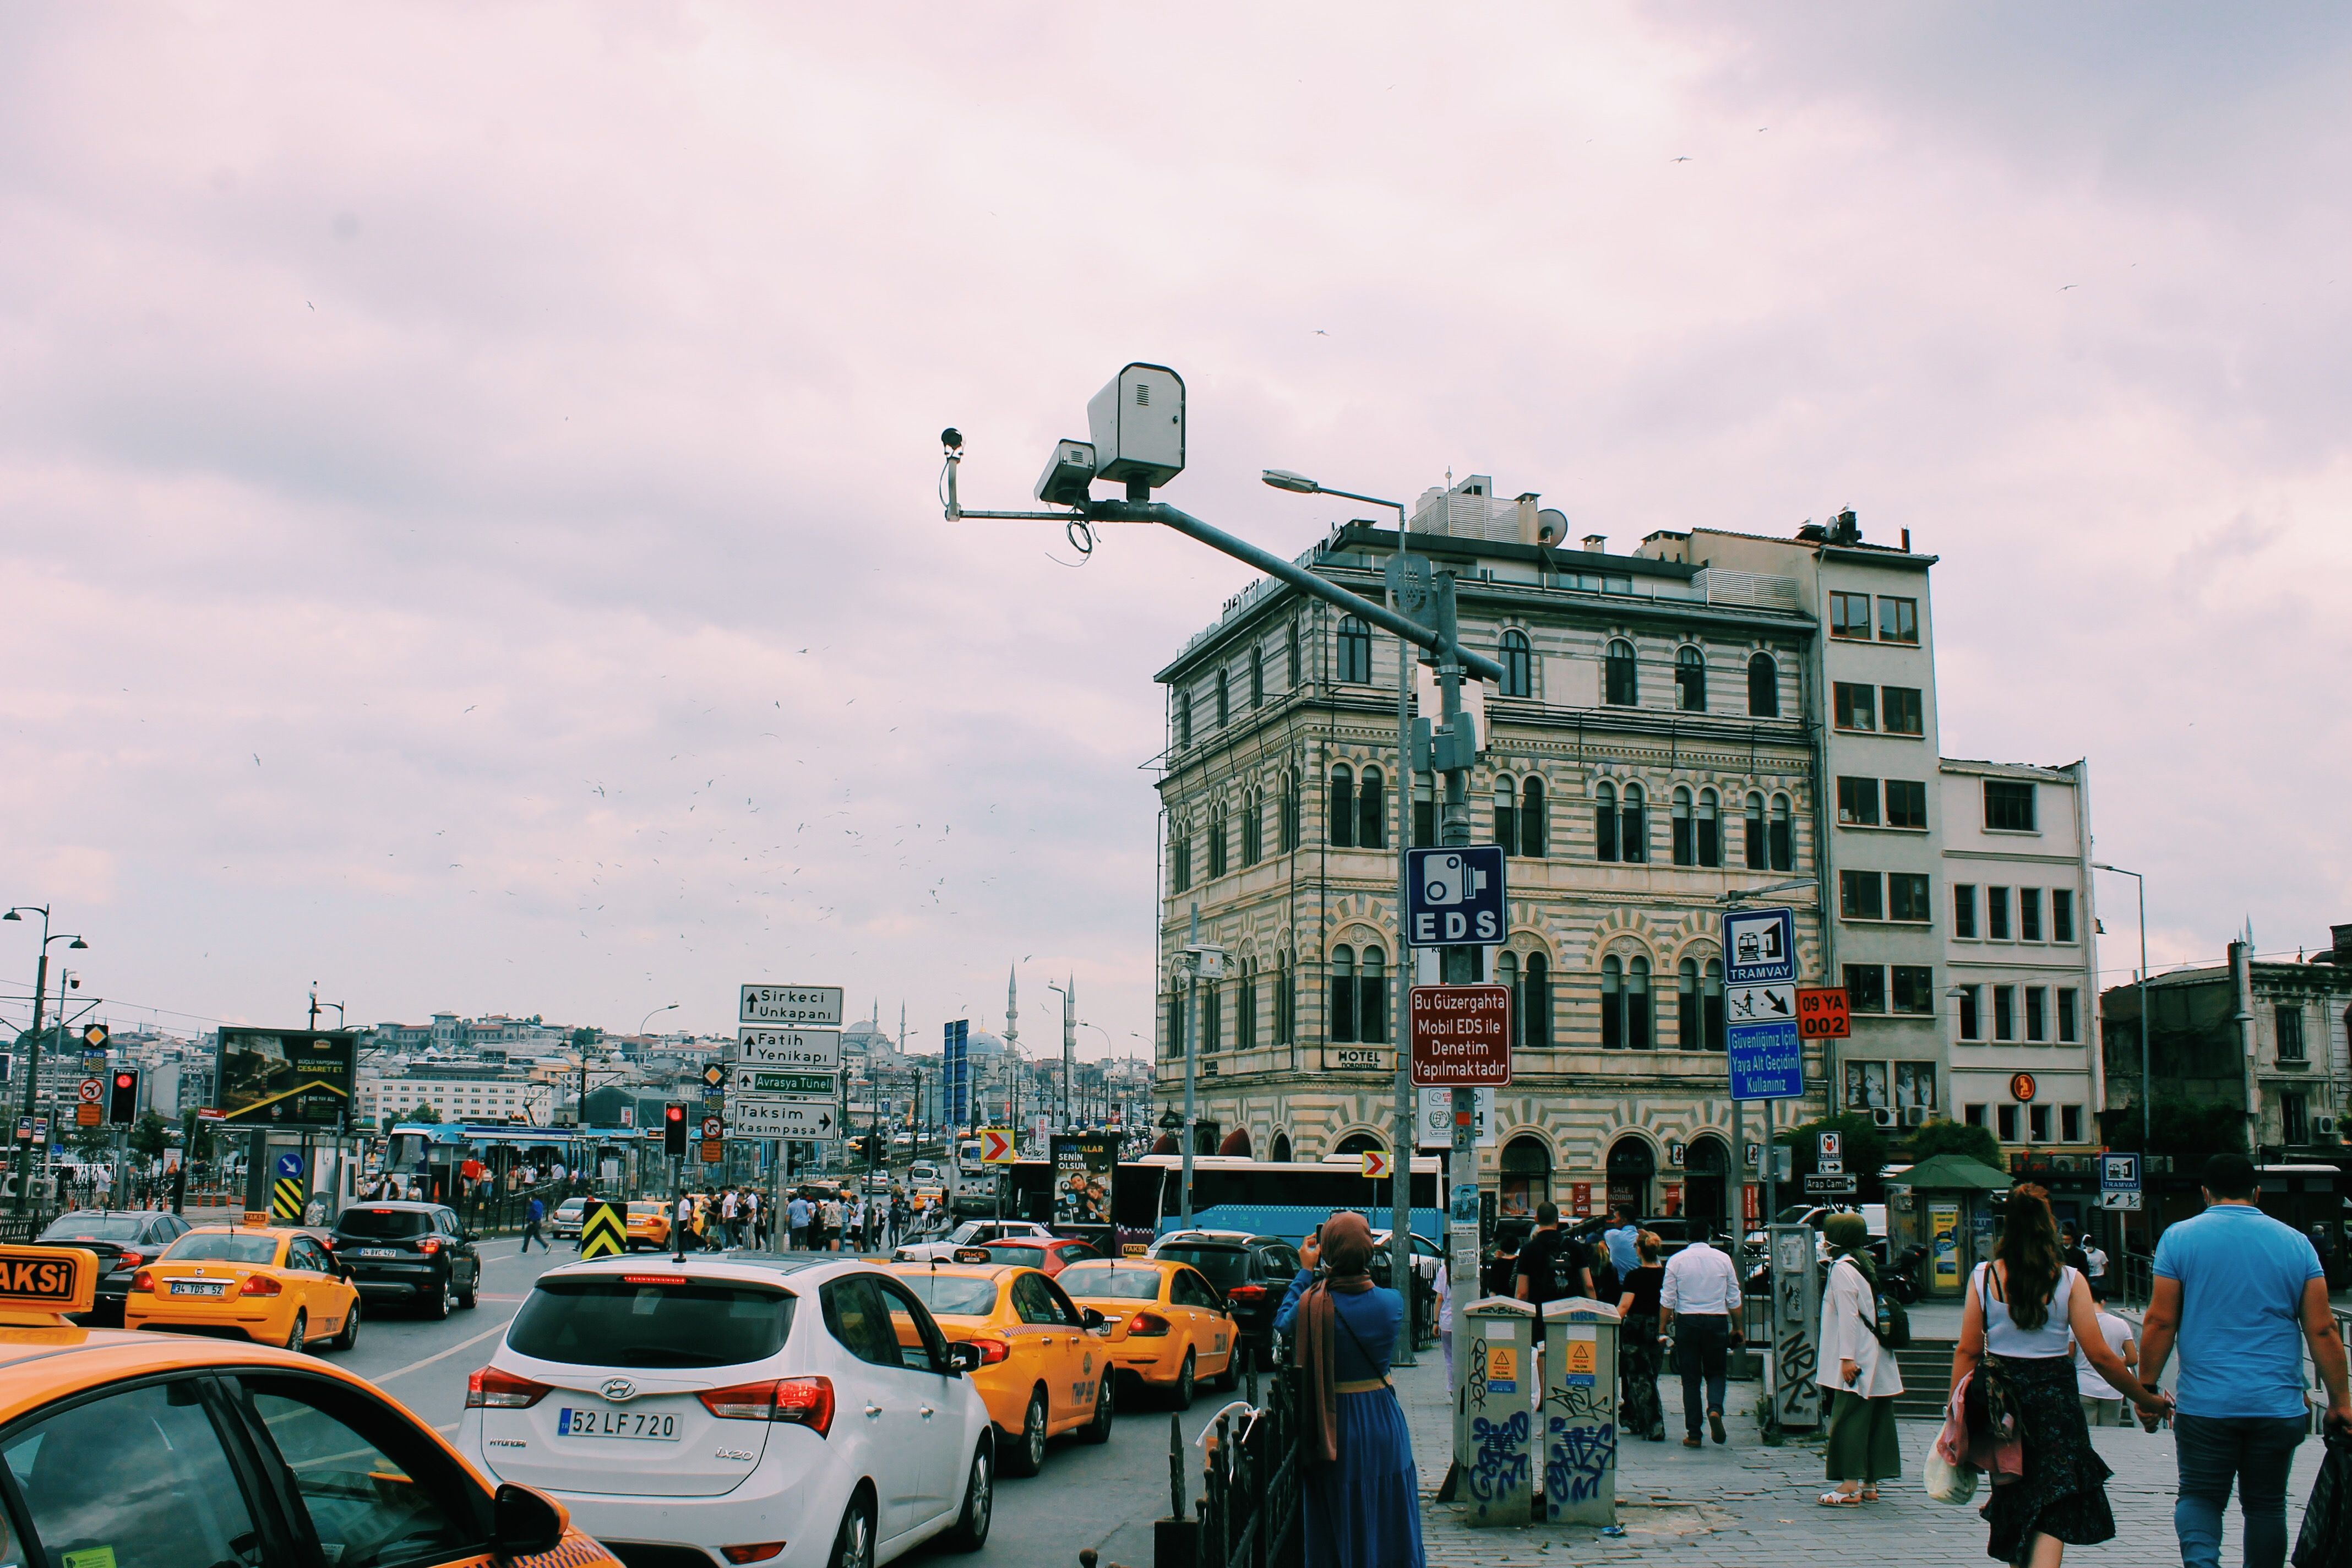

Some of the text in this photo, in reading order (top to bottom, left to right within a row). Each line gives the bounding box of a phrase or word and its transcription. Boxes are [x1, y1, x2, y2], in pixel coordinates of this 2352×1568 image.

[1416, 910, 1496, 940] EDS
[1730, 965, 1789, 979] TRAMVAY
[761, 989, 824, 1003] Sirkeci
[1414, 993, 1505, 1013] Bu Güzergahta
[1803, 995, 1844, 1012] 09 YA
[759, 1006, 831, 1020] Unkapanı
[1418, 1018, 1501, 1035] Mobil EDS ile
[1805, 1016, 1844, 1034] 002
[758, 1033, 803, 1046] Fatih
[1781, 1027, 1796, 1050] İçin
[1431, 1039, 1489, 1056] Denetim
[758, 1048, 827, 1065] Yenikapı
[1338, 1050, 1381, 1062] HOTEL
[1414, 1060, 1506, 1081] Yapılmaktadır
[1732, 1053, 1798, 1076] Yaya Alt Geçidini
[756, 1076, 832, 1090] Avrasya Tüneli
[1746, 1077, 1787, 1093] Kullanınız
[740, 1105, 803, 1119] Taksim
[738, 1123, 816, 1135] Kasımpaşa
[1059, 1143, 1103, 1153] DÜNYALAR
[1058, 1152, 1084, 1161] SENİN
[1807, 1179, 1824, 1190] Arap
[175, 1283, 222, 1294] 34 TDS 52
[573, 1411, 674, 1436] 52 LF 720
[489, 1438, 527, 1447] HYUNDAI
